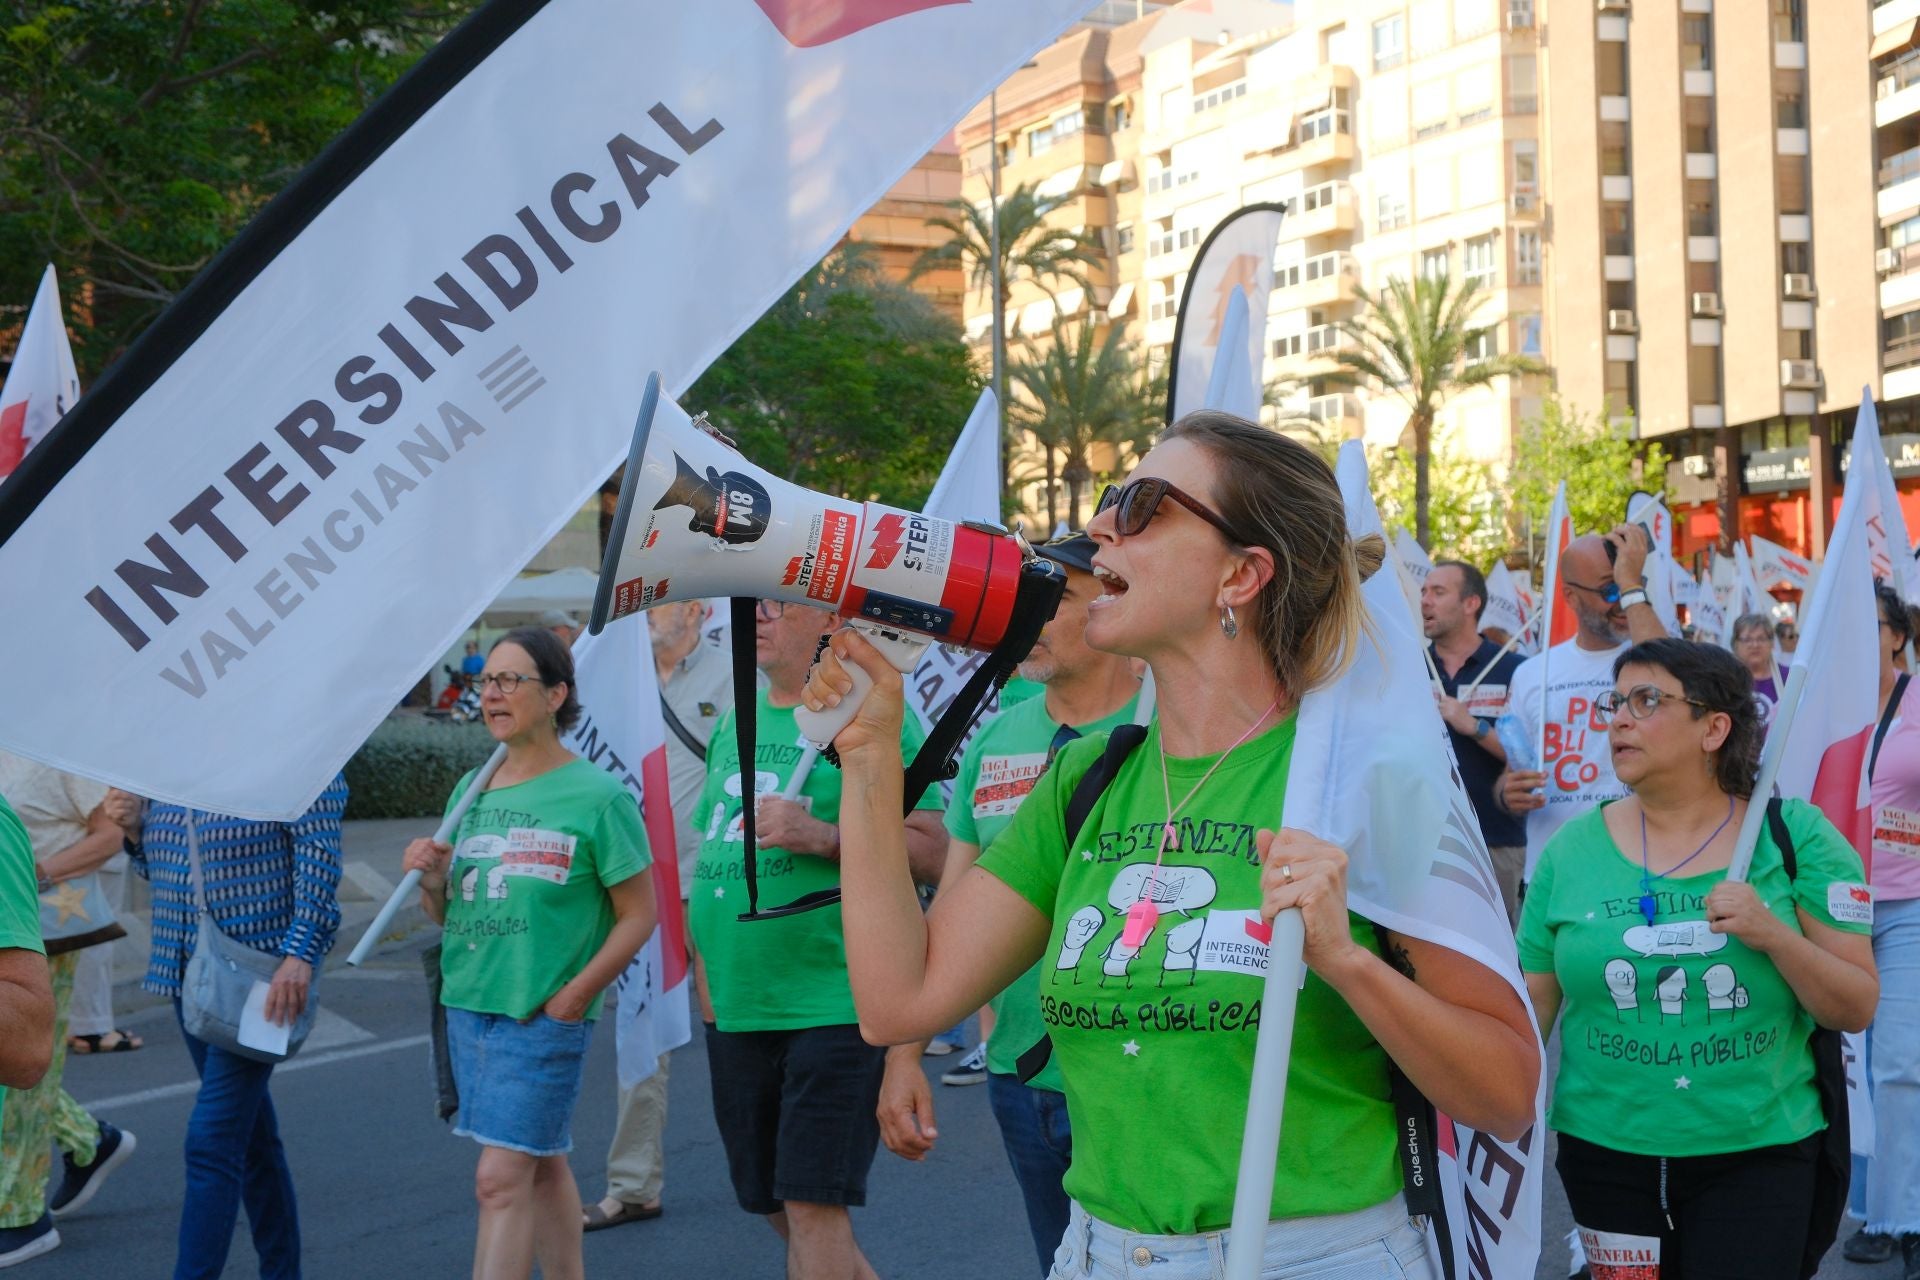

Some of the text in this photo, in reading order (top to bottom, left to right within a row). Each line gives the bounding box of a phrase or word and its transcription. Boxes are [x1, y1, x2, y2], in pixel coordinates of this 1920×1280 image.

[84, 101, 725, 652] INTERSINDICAL
[727, 490, 754, 527] 8M
[158, 401, 486, 699] VALENCIANA
[822, 516, 848, 600] escola pública
[903, 513, 930, 572] STEPV
[799, 552, 815, 587] STEPV
[817, 550, 828, 578] millor
[1550, 794, 1573, 804] SOCIAL
[1137, 996, 1263, 1033] PÚBLICA
[1586, 1025, 1777, 1068] L'ESCOLA PÚBLICA
[1590, 1246, 1656, 1262] GENERAL
